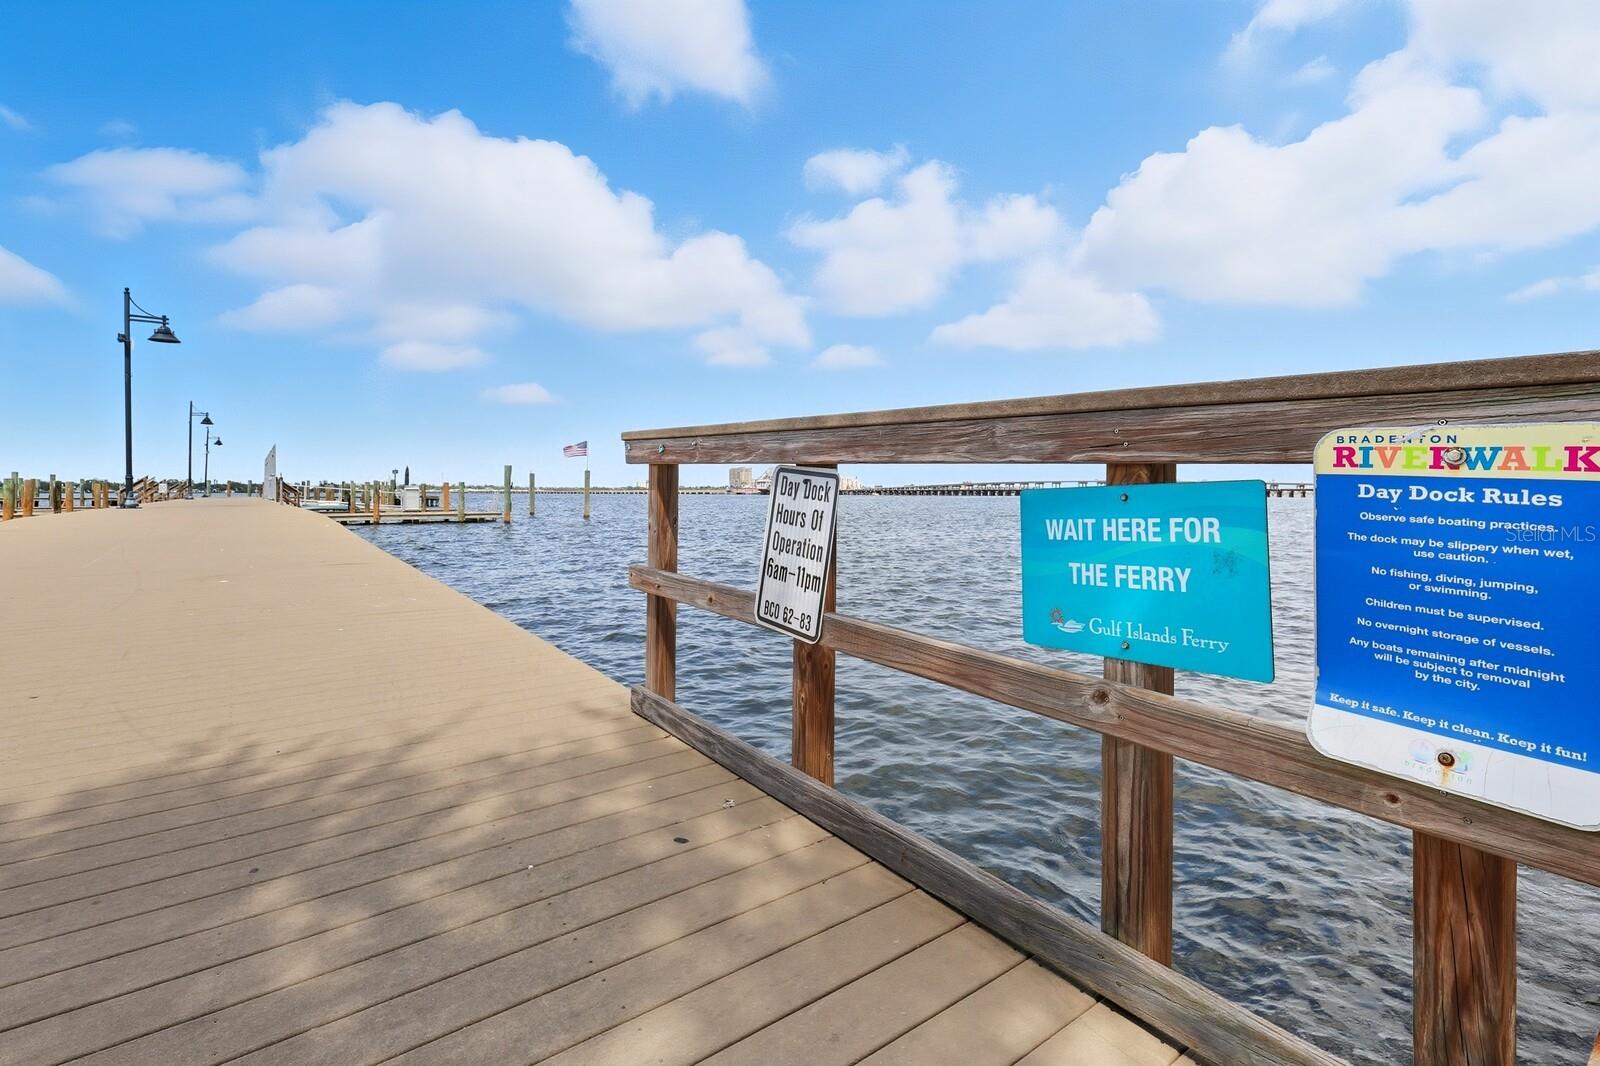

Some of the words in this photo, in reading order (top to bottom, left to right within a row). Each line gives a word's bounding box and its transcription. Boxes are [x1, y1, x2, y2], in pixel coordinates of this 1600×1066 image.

[780, 476, 799, 501] Day
[803, 479, 831, 503] Dock
[1357, 484, 1403, 502] Day
[1409, 485, 1475, 503] Dock
[1482, 488, 1562, 506] Rules
[776, 503, 806, 528] Hours
[811, 509, 824, 531] Of
[1046, 519, 1095, 541] WAIT
[1103, 518, 1161, 542] HERE
[1169, 517, 1221, 544] FOR
[1360, 512, 1406, 523] Observe
[1409, 515, 1435, 524] safe
[1438, 516, 1485, 529] boating
[1490, 520, 1558, 532] practices.
[773, 531, 823, 562] Operation
[1348, 532, 1367, 542] The
[1370, 534, 1397, 544] dock
[1401, 537, 1425, 547] may
[1429, 538, 1444, 548] be
[1447, 540, 1498, 553] slippery
[1502, 545, 1539, 556] when
[1544, 549, 1574, 560] wet,
[1414, 550, 1434, 558] use
[1438, 551, 1488, 564] caution.
[1069, 563, 1107, 587] THE
[1115, 565, 1191, 592] FERRY
[1371, 567, 1386, 575] No
[1390, 569, 1432, 582] fishing,
[1435, 574, 1476, 587] diving,
[1480, 578, 1538, 594] jumping,
[1424, 584, 1491, 600] swimming.
[764, 600, 779, 620] BCO
[1365, 598, 1411, 612] Children
[1415, 605, 1444, 616] must
[1448, 608, 1464, 619] be
[1467, 612, 1544, 630] supervised.
[1089, 618, 1122, 637] Gulf
[1127, 622, 1177, 645] Islands
[1181, 629, 1229, 653] Ferry
[1357, 617, 1372, 626] No
[1375, 620, 1428, 637] overnight
[1432, 630, 1479, 645] storage
[1483, 637, 1496, 646] of
[1500, 641, 1555, 657] vessels.
[1349, 636, 1369, 649] Any
[1372, 640, 1403, 653] boats
[1406, 647, 1466, 665] remaining
[1469, 657, 1500, 670] after
[1503, 663, 1565, 683] midnight
[1374, 652, 1393, 662] will
[1396, 656, 1409, 665] be
[1413, 659, 1457, 675] subject
[1460, 667, 1473, 677] to
[1477, 672, 1530, 688] removal
[1415, 670, 1429, 681] by
[1432, 673, 1452, 685] the
[1455, 678, 1480, 691] city.
[1329, 693, 1358, 709] Keep
[1361, 700, 1370, 710] it
[1372, 703, 1400, 717] safe.
[1403, 710, 1436, 728] Keep
[1439, 719, 1449, 729] it
[1452, 722, 1494, 740] clean.
[1497, 732, 1536, 751] Keep
[1540, 743, 1552, 754] it
[1555, 746, 1587, 762] fun!
